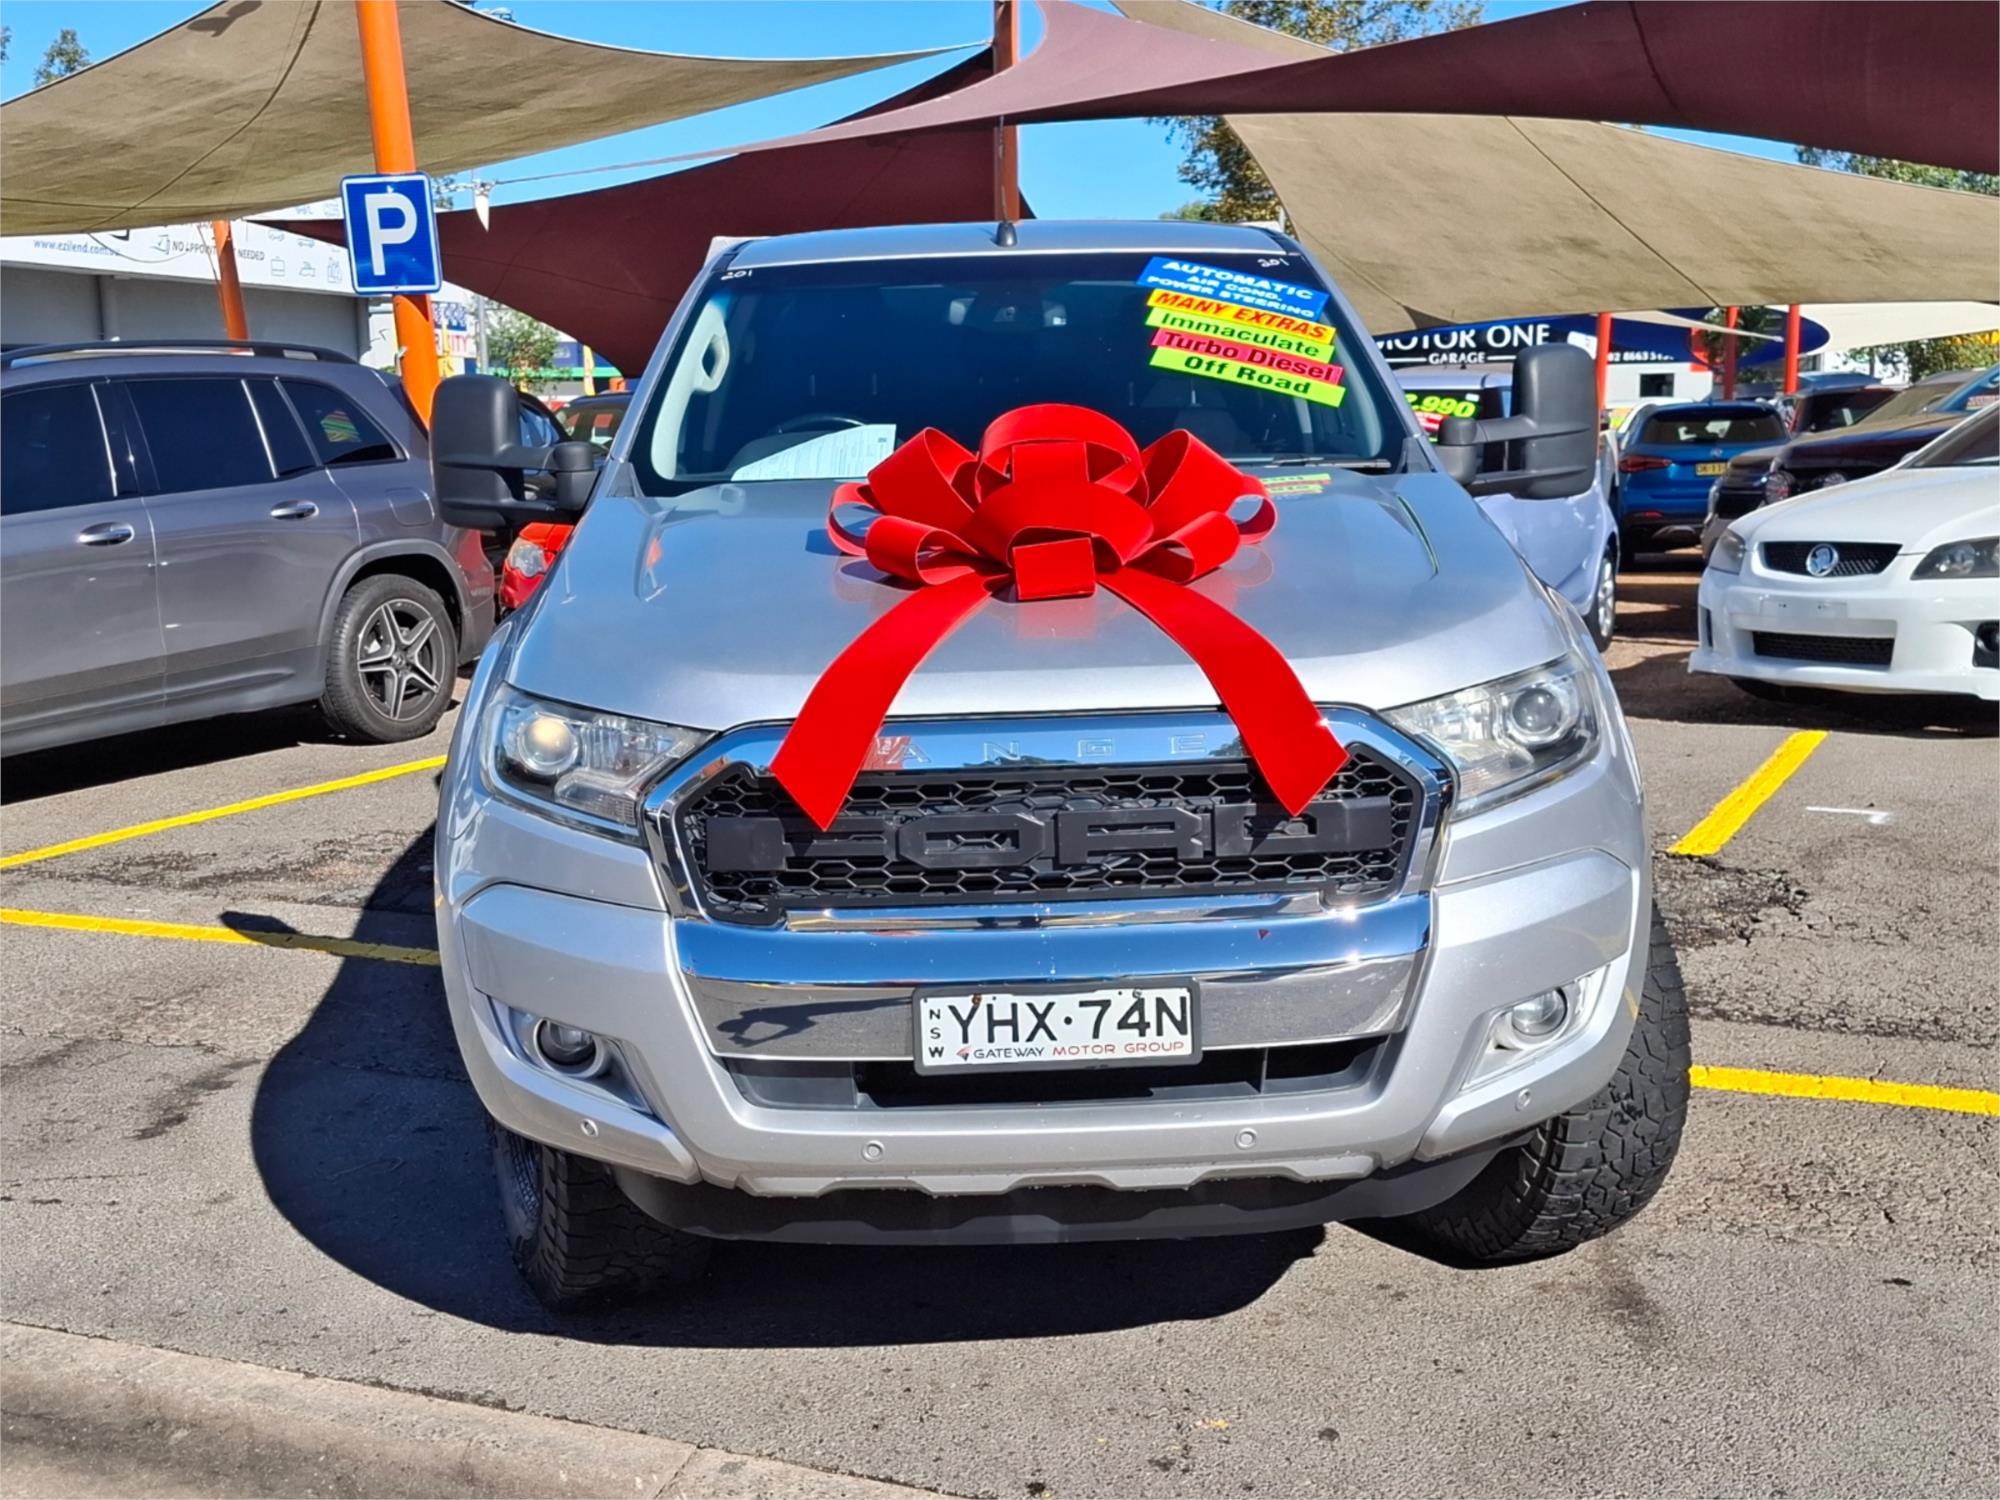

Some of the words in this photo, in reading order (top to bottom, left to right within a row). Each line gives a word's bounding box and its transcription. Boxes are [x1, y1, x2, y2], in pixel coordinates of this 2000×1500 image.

[365, 193, 417, 276] P
[1147, 276, 1215, 295] POWER
[1219, 291, 1315, 318] STEERING
[1162, 262, 1315, 300] AUTOMATIC
[1187, 275, 1220, 288] AIR
[1225, 283, 1282, 302] COND.
[1155, 292, 1229, 314] MANY
[1233, 307, 1328, 339] EXTRAS
[1161, 314, 1320, 357] Immaculate
[1486, 324, 1550, 348] ONE
[1164, 331, 1240, 358] Turbo
[1247, 348, 1333, 381] Diesel
[1184, 355, 1229, 375] Off
[1236, 366, 1312, 394] Road
[1428, 352, 1486, 365] GARAGE
[886, 734, 1208, 765] ANGE
[973, 1047, 1045, 1060] GATEWAY
[1053, 1043, 1116, 1057] MOTOR
[1124, 1041, 1185, 1055] GROUP
